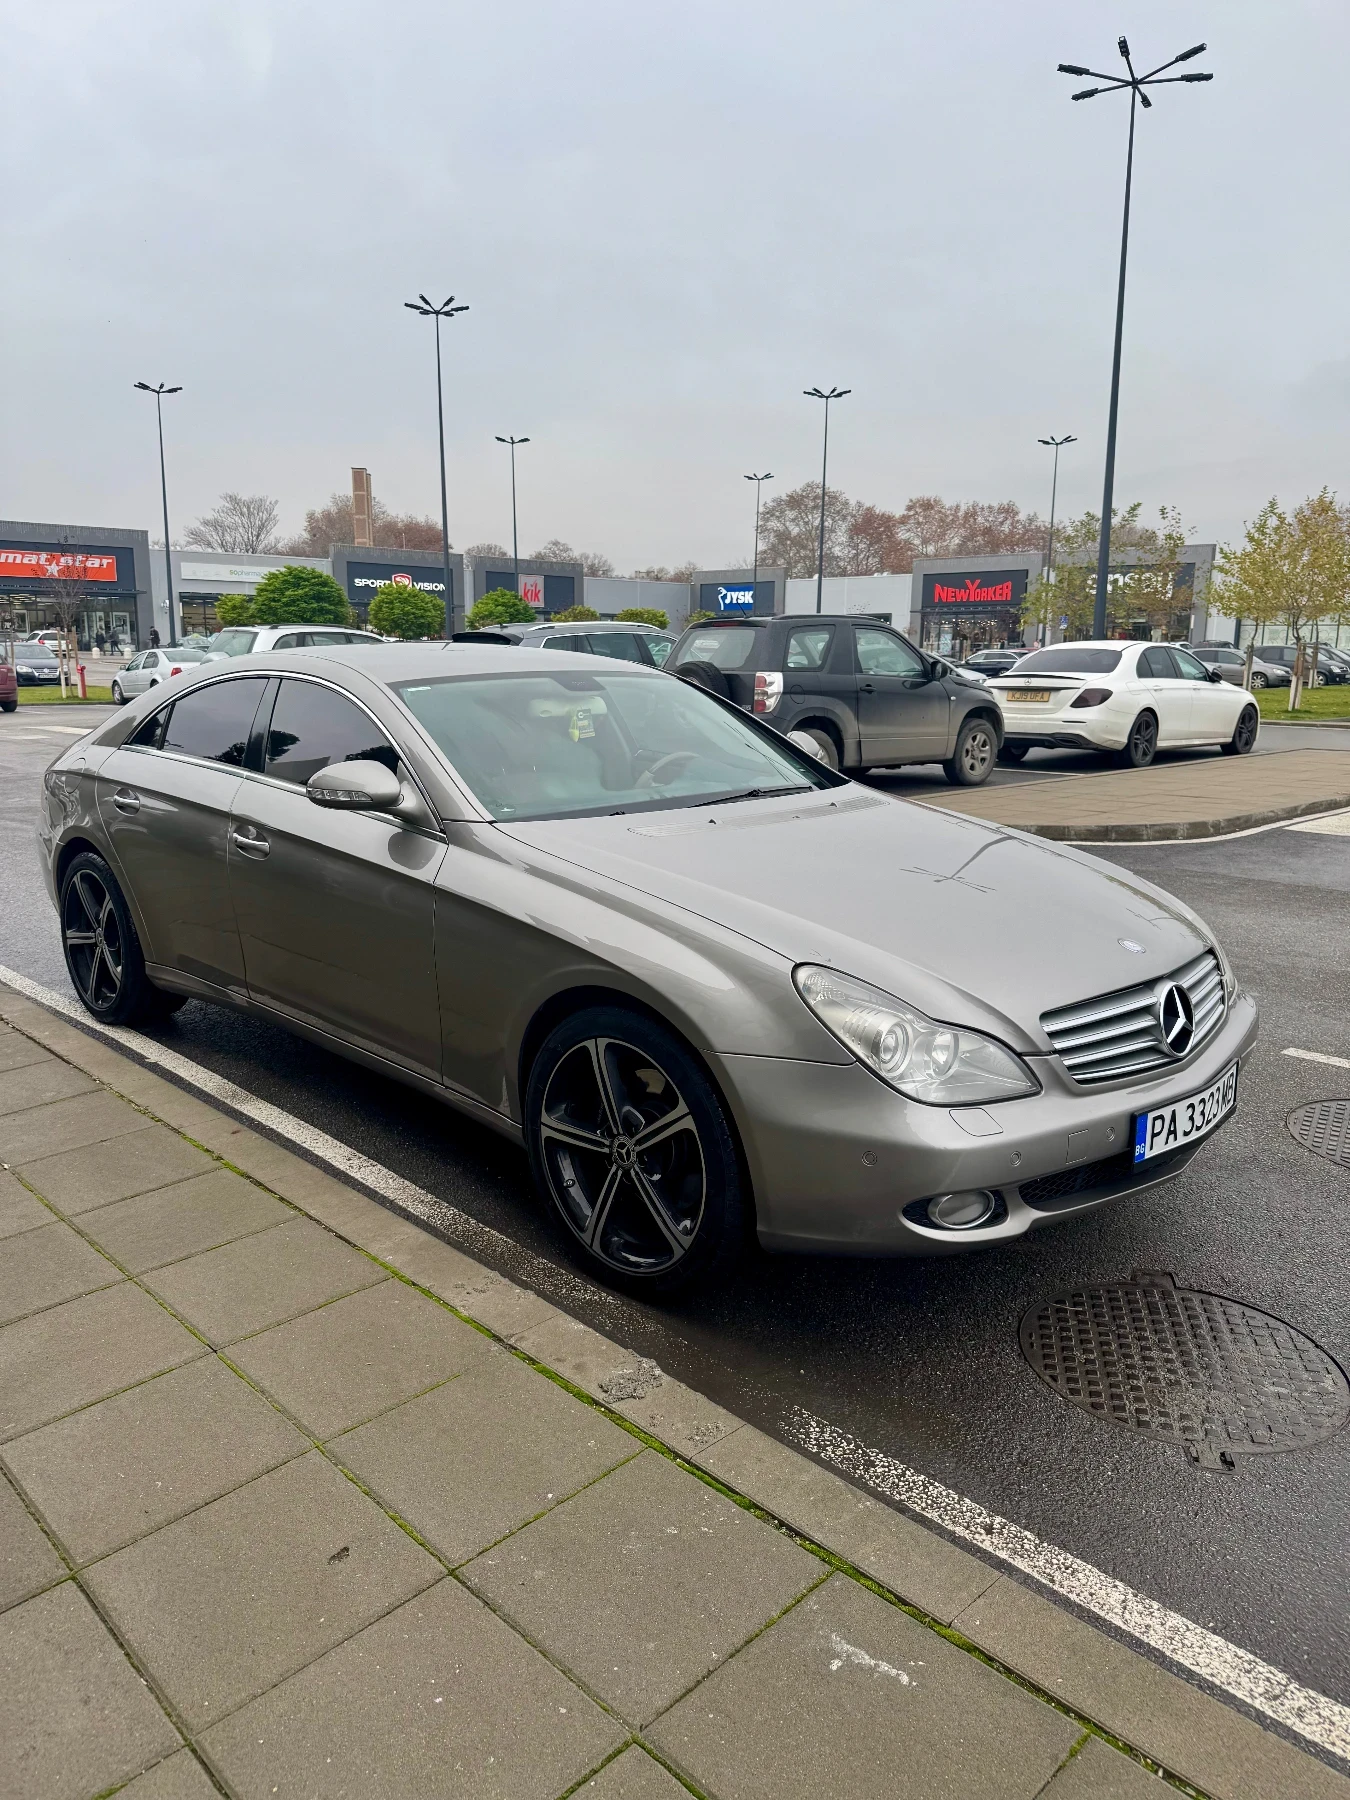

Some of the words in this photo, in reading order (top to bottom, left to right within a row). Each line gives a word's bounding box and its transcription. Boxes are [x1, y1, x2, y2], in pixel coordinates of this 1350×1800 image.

[0, 552, 50, 565] mat
[59, 555, 112, 568] star
[354, 578, 391, 588] SPORT
[725, 591, 754, 604] JYSK
[1149, 1108, 1178, 1151] PA
[1183, 1085, 1220, 1137] 3323
[1135, 1142, 1145, 1156] BG
